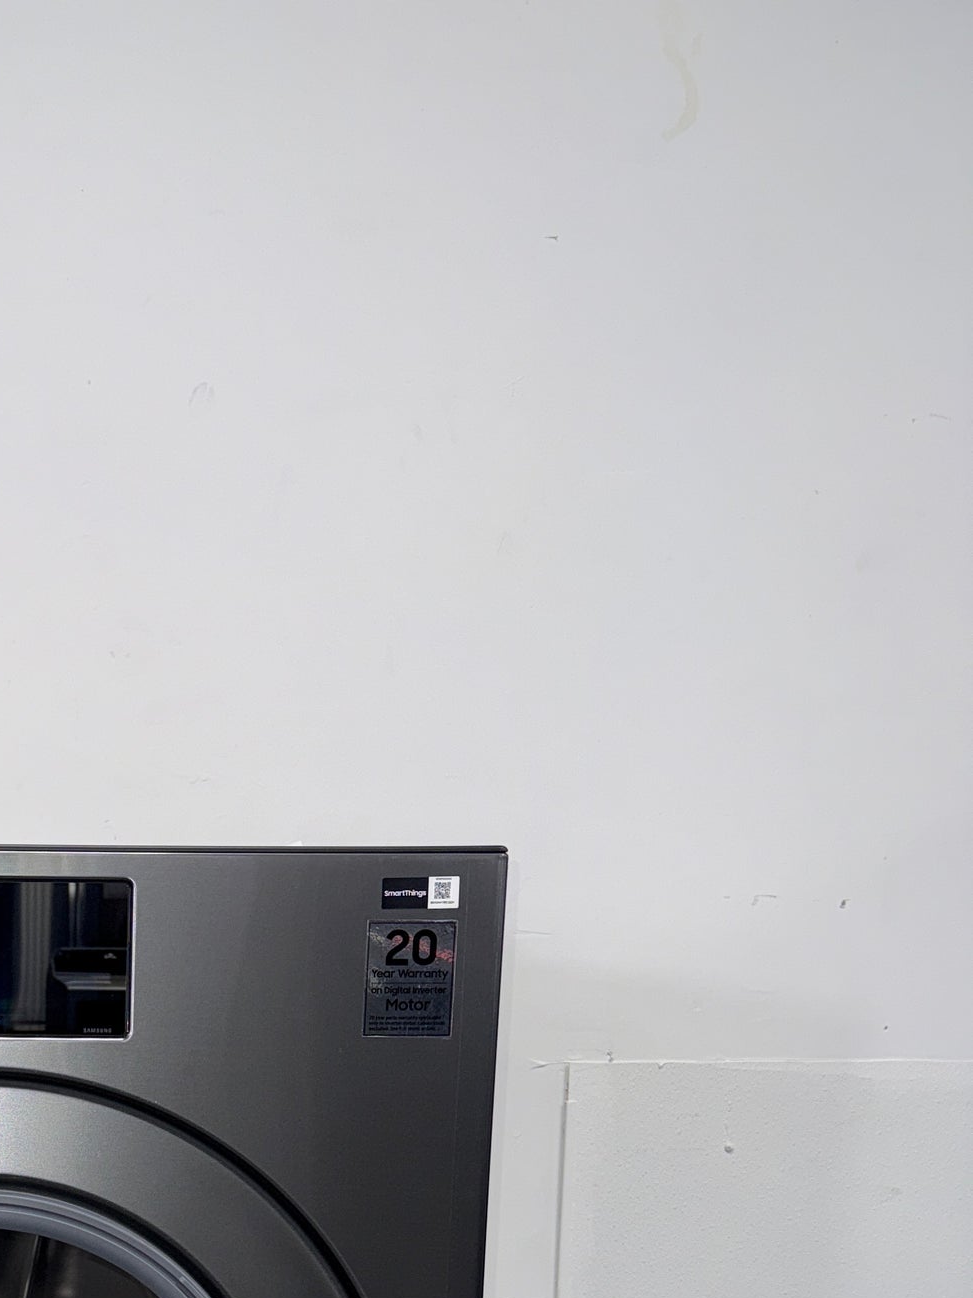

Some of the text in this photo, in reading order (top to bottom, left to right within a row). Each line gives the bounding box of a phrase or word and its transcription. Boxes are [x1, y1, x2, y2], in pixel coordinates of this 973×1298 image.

[384, 889, 427, 898] SmartThings
[385, 929, 438, 966] 20
[371, 969, 449, 980] Year Warranty
[384, 986, 411, 996] Digital
[412, 986, 447, 994] Inverter
[385, 999, 432, 1012] Motor
